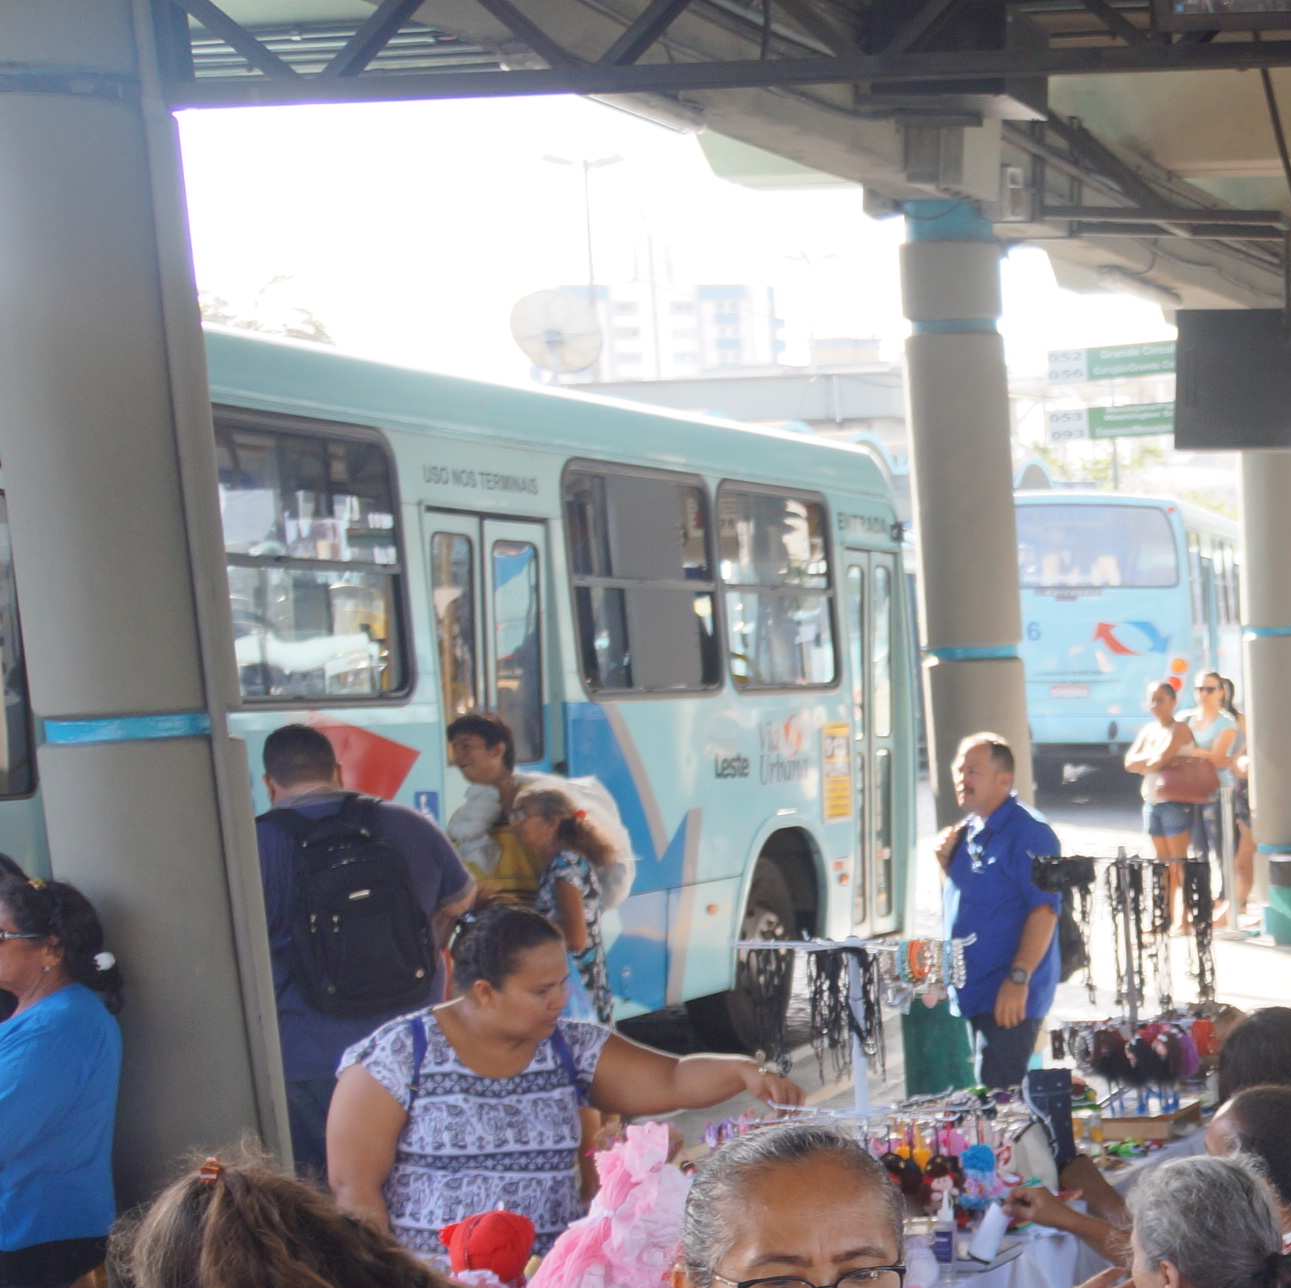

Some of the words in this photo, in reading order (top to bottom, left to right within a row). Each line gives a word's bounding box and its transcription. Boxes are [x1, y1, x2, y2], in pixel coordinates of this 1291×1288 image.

[1050, 352, 1082, 363] 052
[1050, 369, 1083, 380] 056
[1050, 412, 1082, 423] 053
[423, 465, 449, 486] USO
[451, 469, 477, 491] NOS
[476, 471, 540, 496] TERMINAIS
[837, 511, 888, 534] ENTRADA
[1027, 622, 1041, 642] 6
[715, 753, 751, 780] Leste
